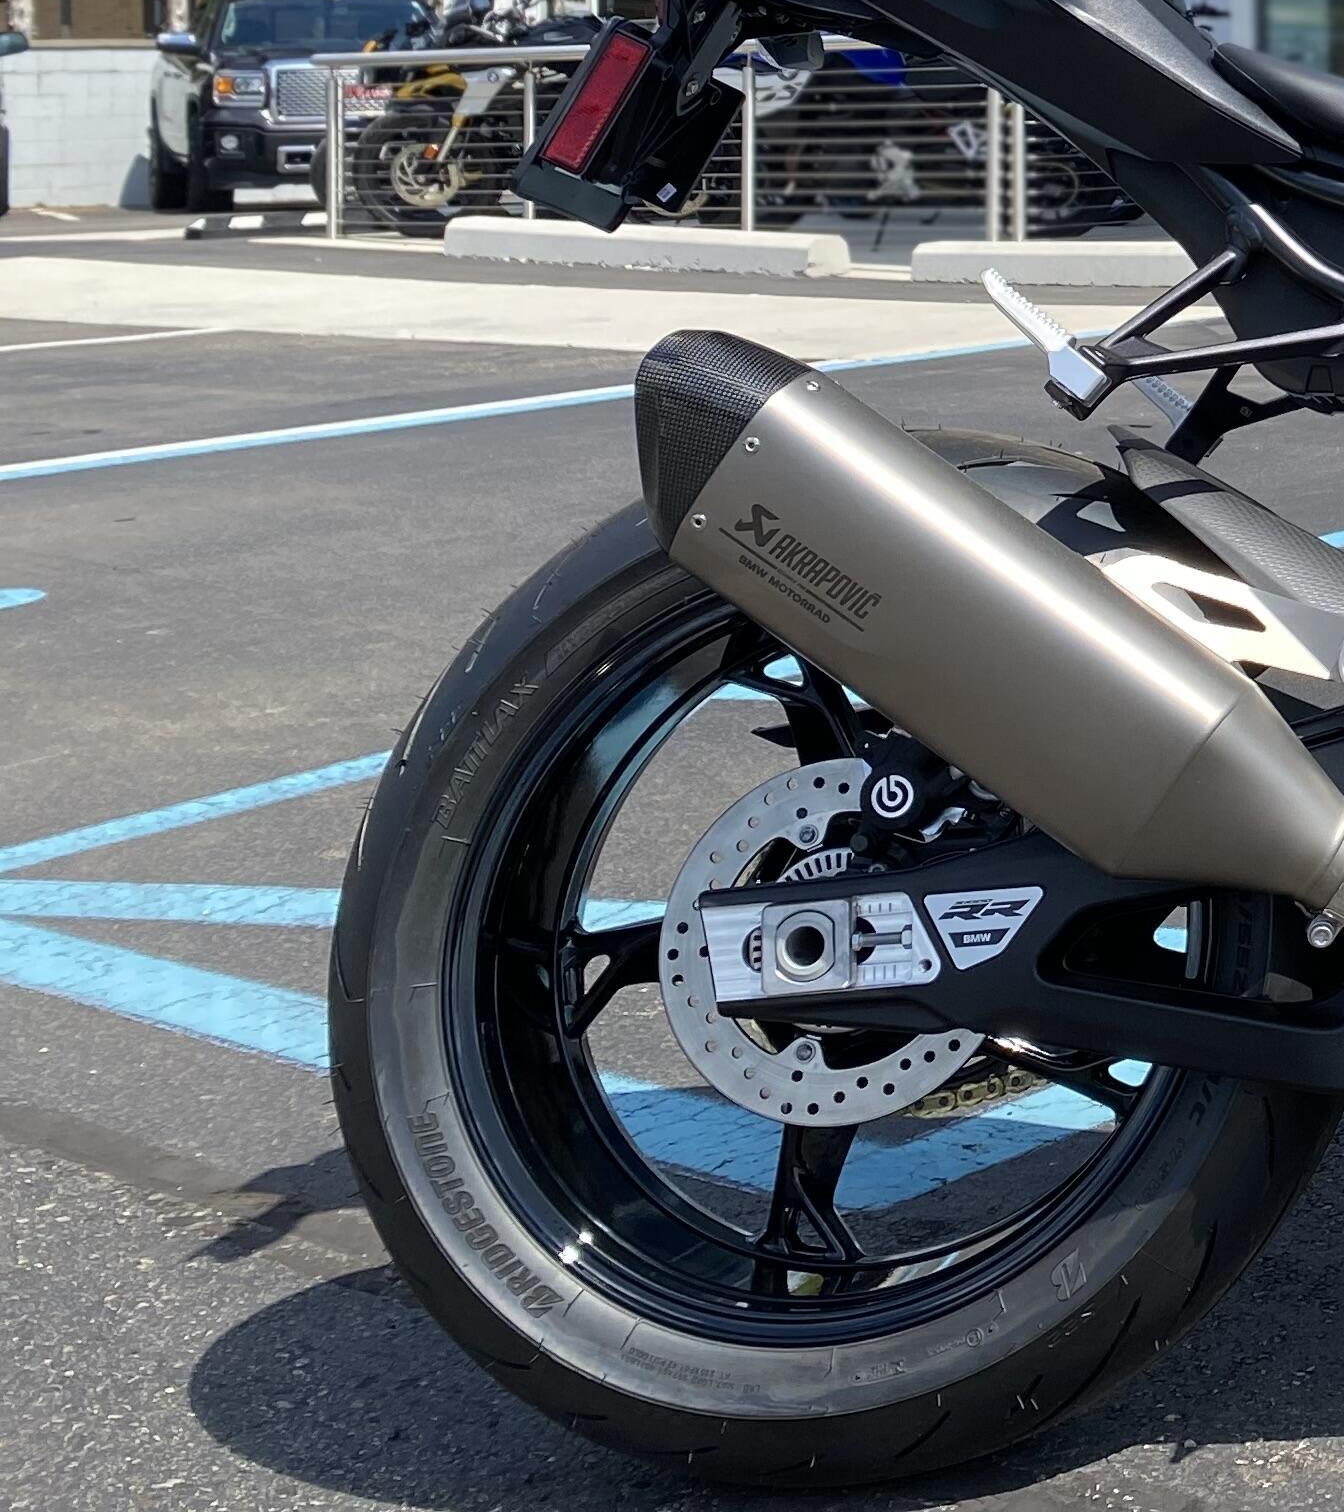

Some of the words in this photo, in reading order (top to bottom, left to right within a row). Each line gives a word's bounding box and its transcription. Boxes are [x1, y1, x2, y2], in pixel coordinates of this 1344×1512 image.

[738, 554, 768, 579] BMW
[767, 574, 831, 624] MOTORRAD
[938, 899, 1030, 920] RR
[963, 932, 992, 944] BMW
[406, 1111, 565, 1319] BRIDGESTONE
